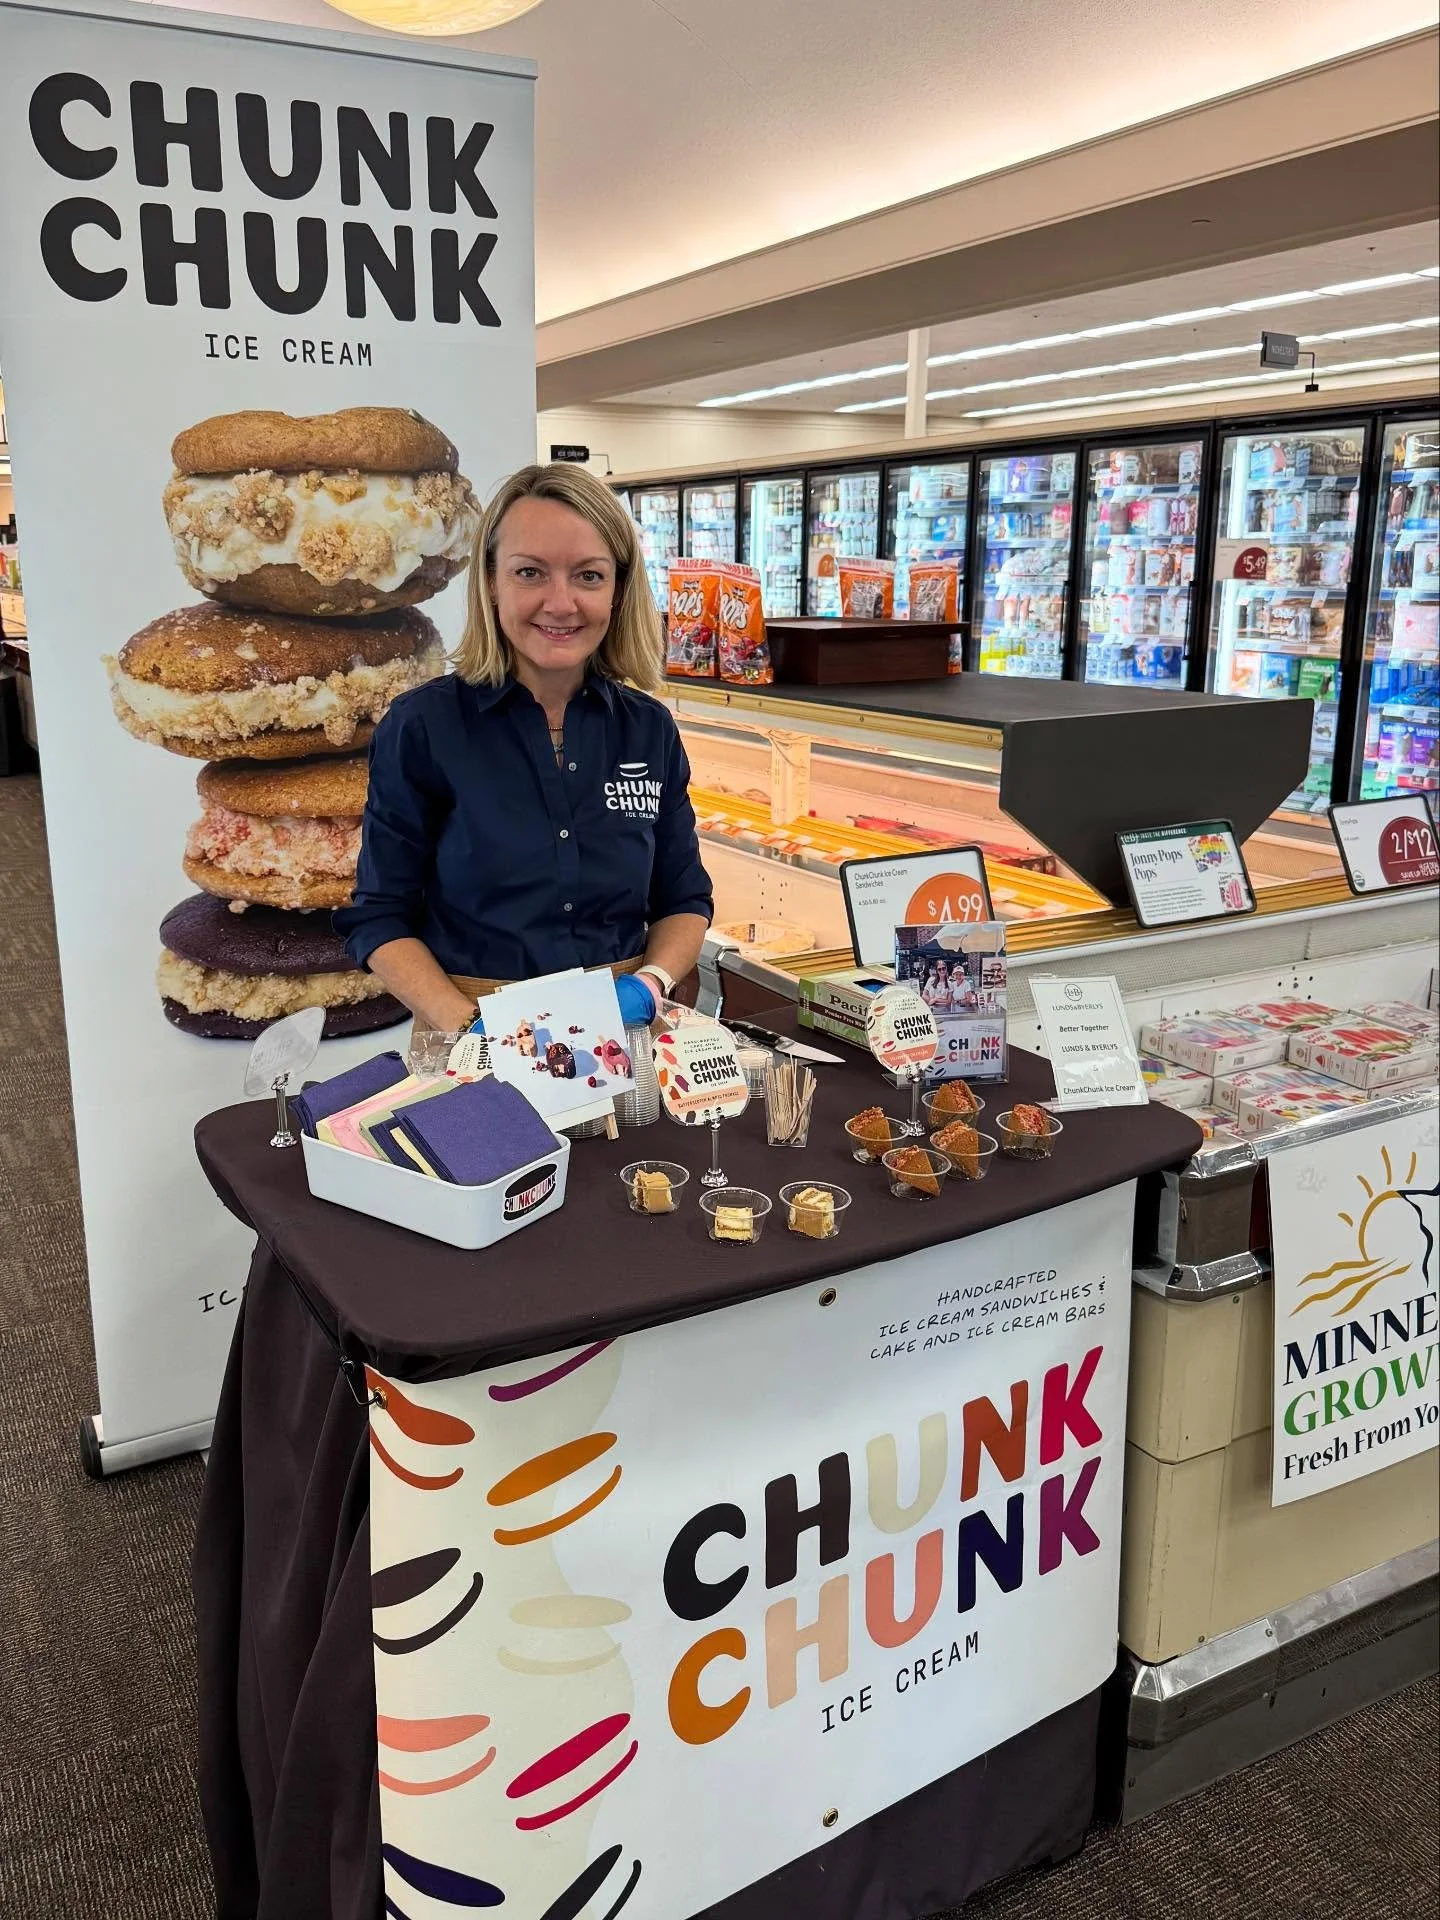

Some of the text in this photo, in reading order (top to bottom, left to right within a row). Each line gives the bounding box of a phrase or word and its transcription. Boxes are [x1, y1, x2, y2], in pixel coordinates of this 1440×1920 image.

[28, 72, 499, 219] CHUNK
[40, 197, 502, 327] CHUNK
[204, 333, 373, 367] ICE CREAM
[1134, 868, 1157, 882] Pops
[927, 893, 982, 924] $4.99
[893, 1014, 931, 1030] CHUNK
[896, 1024, 934, 1040] CHUNK
[1081, 1025, 1109, 1033] Together
[689, 1054, 736, 1073] CHUNK
[1061, 1045, 1084, 1053] LUNDS
[1091, 1043, 1119, 1051] BYERLYS
[693, 1066, 740, 1085] CHUNK
[1063, 1086, 1103, 1094] ChunkChunk
[198, 1290, 238, 1312] IC
[937, 1269, 1057, 1306] HANDCRAFTED
[879, 1320, 910, 1338] ICE
[917, 1308, 974, 1330] CREAM
[980, 1283, 1093, 1317] SANDWICHES
[870, 1303, 1106, 1359] CAKE AND ICE CREAM BARS
[1283, 1292, 1438, 1386] MINNE
[1284, 1343, 1439, 1436] GROW
[1284, 1437, 1348, 1480] Fresh
[1354, 1416, 1411, 1454] From
[663, 1345, 1104, 1621] CHUNK
[667, 1456, 1102, 1745] CHUNK
[821, 1630, 981, 1733] ICE CREAM
